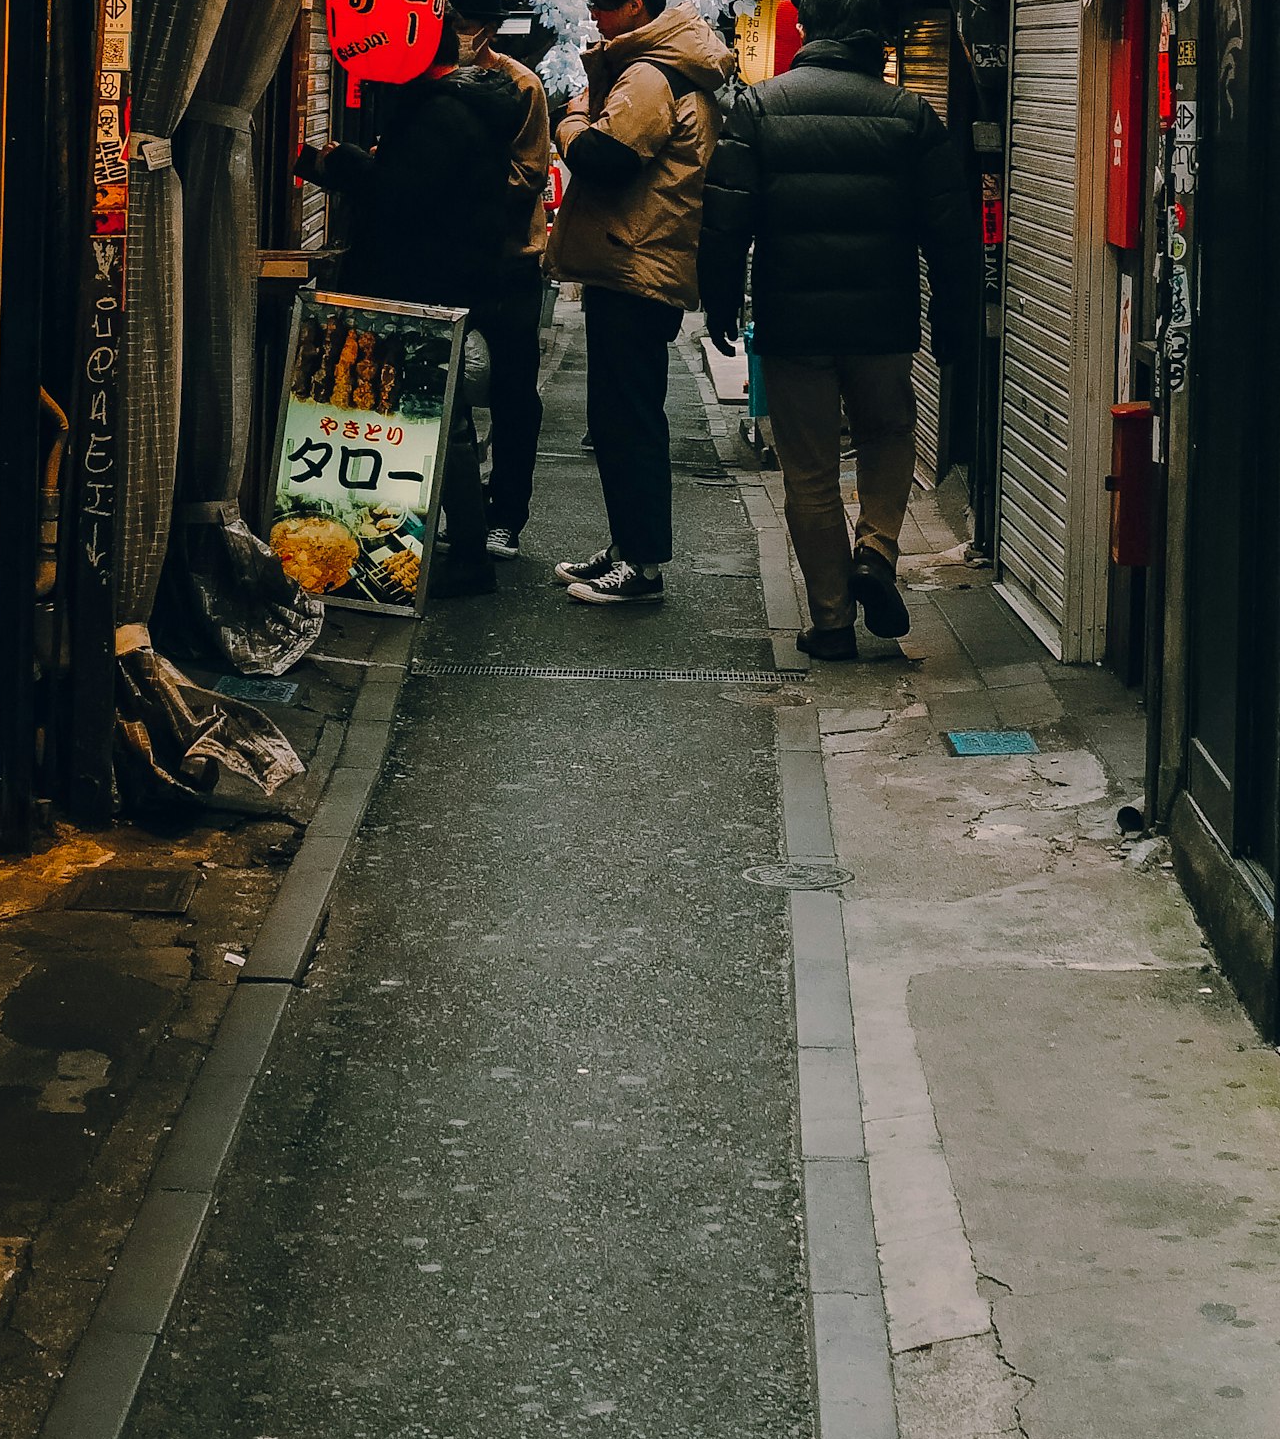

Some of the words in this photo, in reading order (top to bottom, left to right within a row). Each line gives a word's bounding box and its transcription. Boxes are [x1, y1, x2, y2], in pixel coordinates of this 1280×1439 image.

[319, 415, 405, 447] やきとり
[287, 436, 425, 491] タロー
